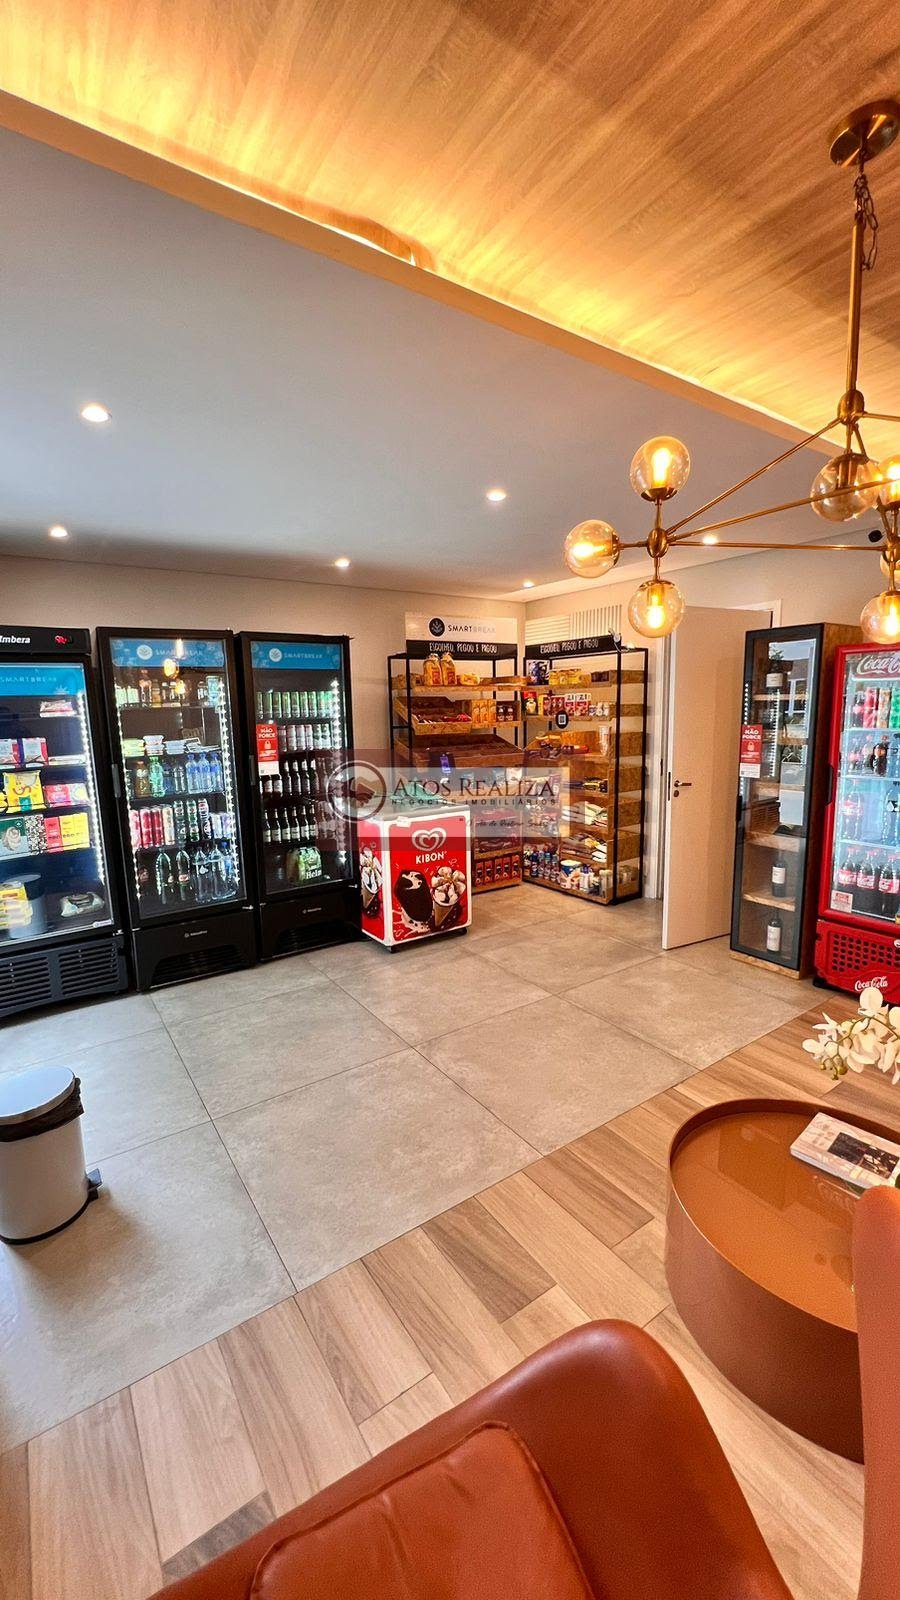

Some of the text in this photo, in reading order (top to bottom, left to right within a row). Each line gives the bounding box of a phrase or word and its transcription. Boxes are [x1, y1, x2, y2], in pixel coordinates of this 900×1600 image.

[457, 643, 475, 653] PEGOU
[476, 644, 480, 653] E
[415, 851, 445, 865] KIBON
